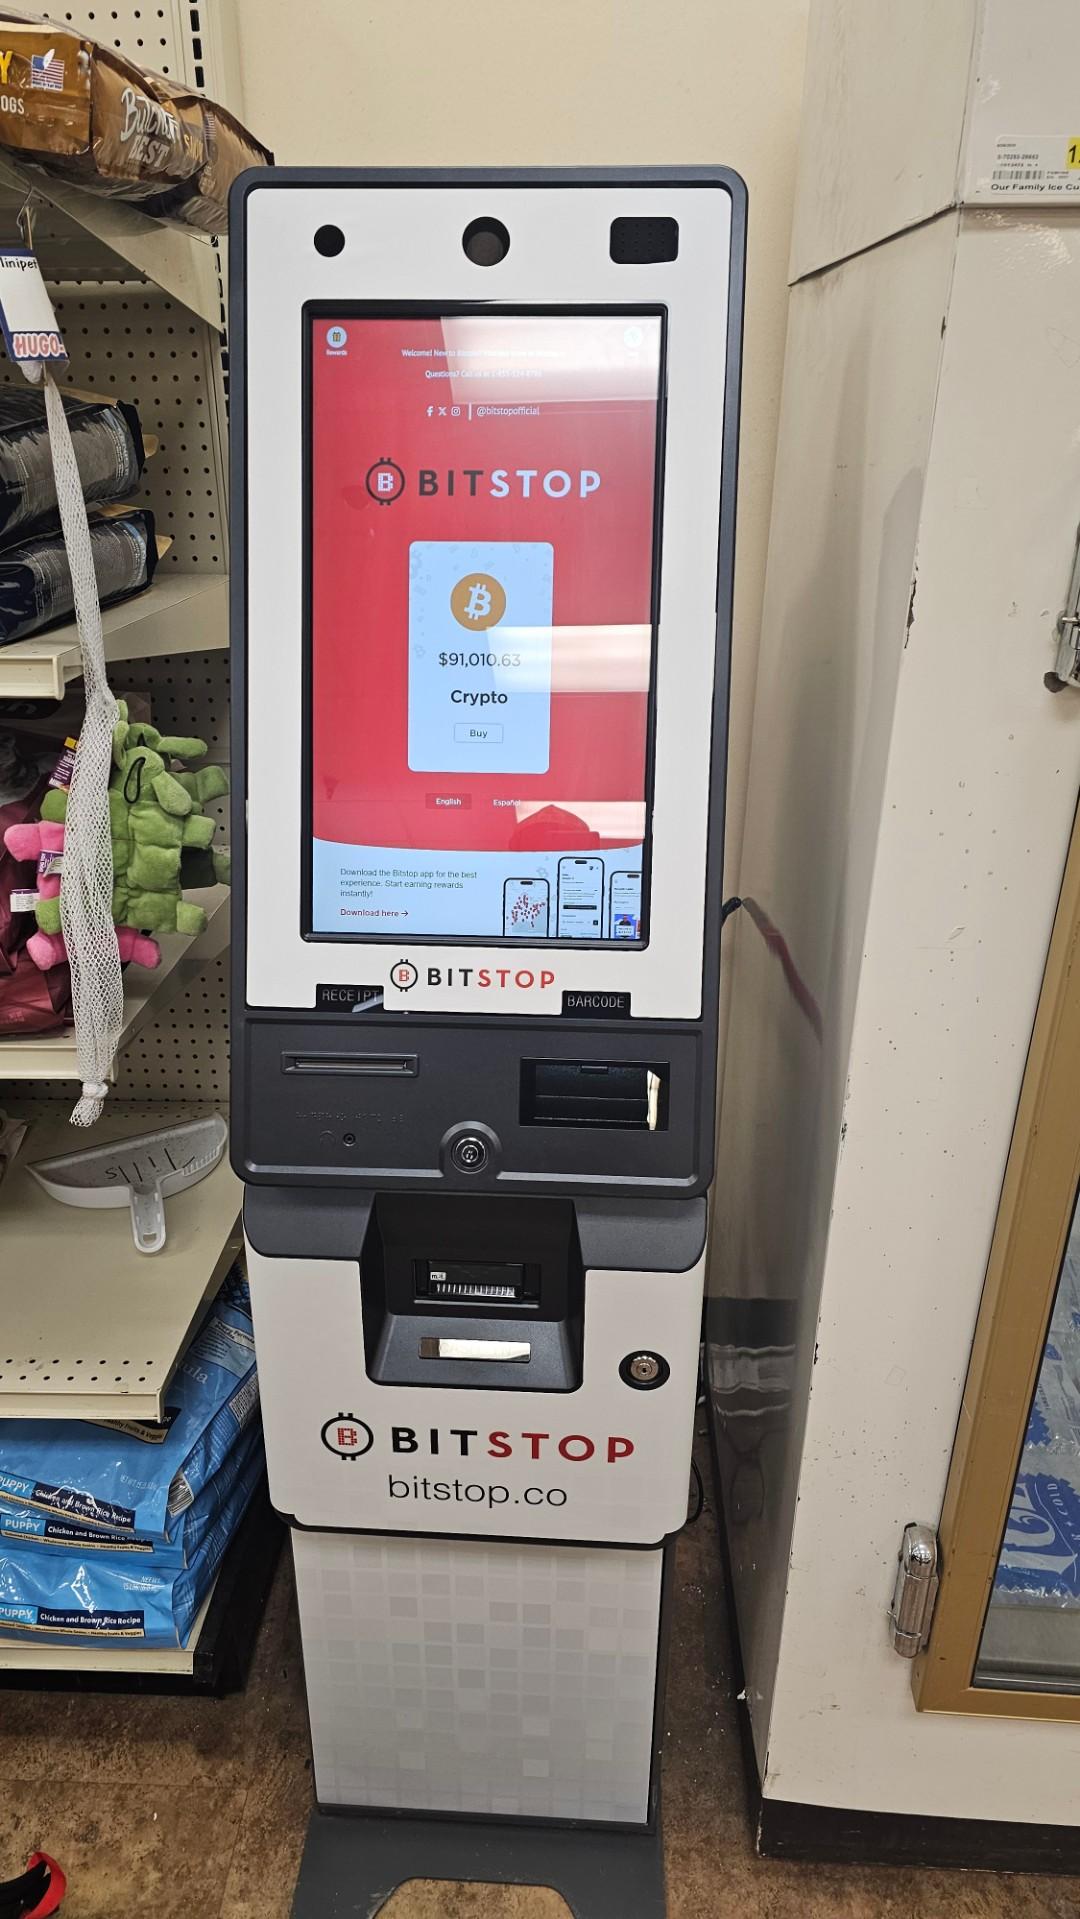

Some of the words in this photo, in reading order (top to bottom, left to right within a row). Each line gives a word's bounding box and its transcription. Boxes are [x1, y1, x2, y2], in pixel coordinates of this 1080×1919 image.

[0, 94, 25, 115] OGS
[1012, 183, 1045, 192] Family
[402, 349, 432, 357] Welcome!
[425, 369, 460, 379] Questions?
[477, 406, 540, 418] @bitstopofficial
[418, 469, 601, 498] BITSTOP
[438, 652, 521, 668] $91,010.63
[450, 689, 508, 705] Crypto
[469, 729, 488, 739] Buy
[436, 798, 461, 807] English
[493, 799, 520, 807] Español
[340, 868, 377, 877] Download
[379, 869, 391, 877] the
[392, 869, 418, 879] Bitstop
[420, 871, 434, 879] app
[436, 870, 445, 878] for
[461, 871, 477, 879] best
[340, 880, 382, 888] experience.
[385, 880, 402, 888] Start
[404, 881, 432, 889] earning
[434, 881, 464, 889] rewards
[340, 890, 374, 899] instantly!
[340, 908, 379, 917] Download
[381, 909, 399, 917] here
[427, 968, 555, 989] BITSTOP
[322, 988, 380, 1001] RECEIPT
[566, 995, 625, 1009] BARCODE
[391, 1427, 635, 1463] BITSTOP
[388, 1474, 568, 1508] bitstop.co
[35, 1489, 61, 1502] Chicken
[62, 1496, 74, 1506] and
[75, 1500, 95, 1512] Brown
[97, 1508, 110, 1518] Rice
[112, 1512, 131, 1524] Recipe
[5, 1519, 40, 1531] PUPPY
[48, 1526, 74, 1536] Chicken
[88, 1532, 110, 1540] Brown
[111, 1533, 125, 1541] Rice
[40, 1613, 64, 1622] Chicken
[66, 1615, 79, 1623] and
[80, 1615, 102, 1624] Brown
[104, 1616, 117, 1624] Rice
[118, 1616, 140, 1625] Recipe
